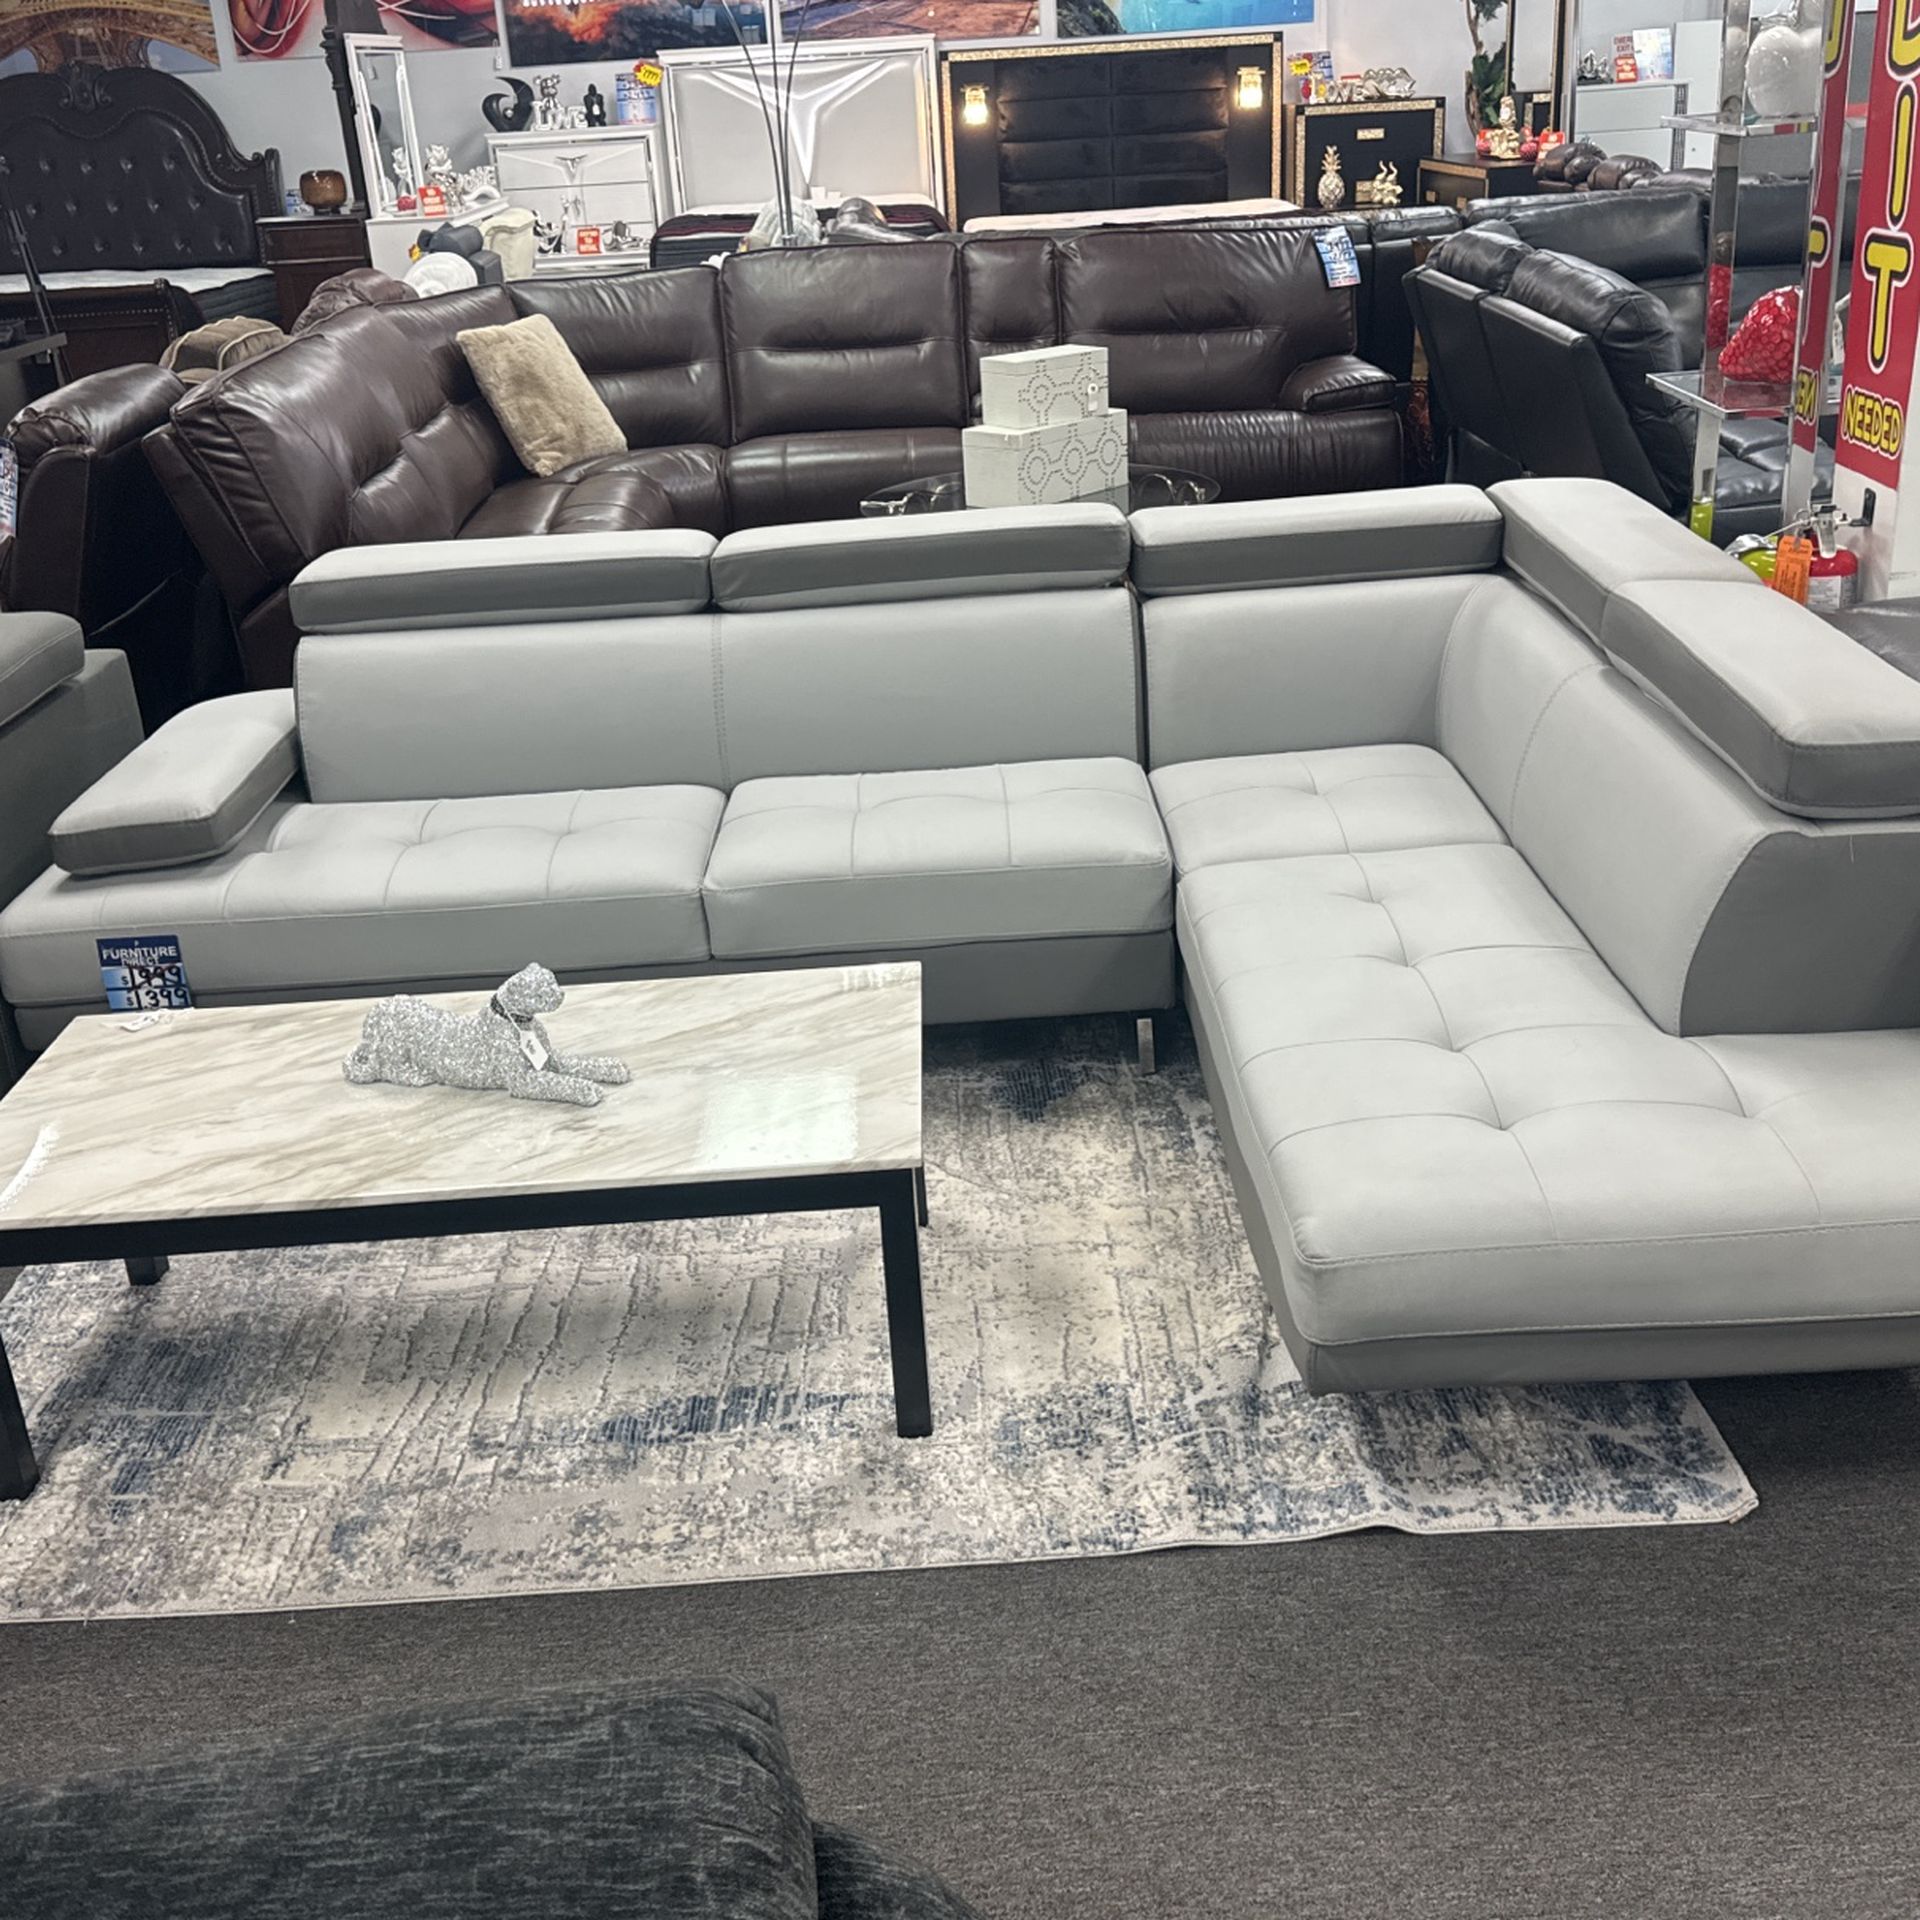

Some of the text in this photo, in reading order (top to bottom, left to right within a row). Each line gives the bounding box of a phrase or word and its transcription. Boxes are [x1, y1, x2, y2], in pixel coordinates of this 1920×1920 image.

[1841, 385, 1904, 460] NEEDED
[102, 945, 178, 960] FURNITURE
[121, 957, 159, 968] DIRECT
